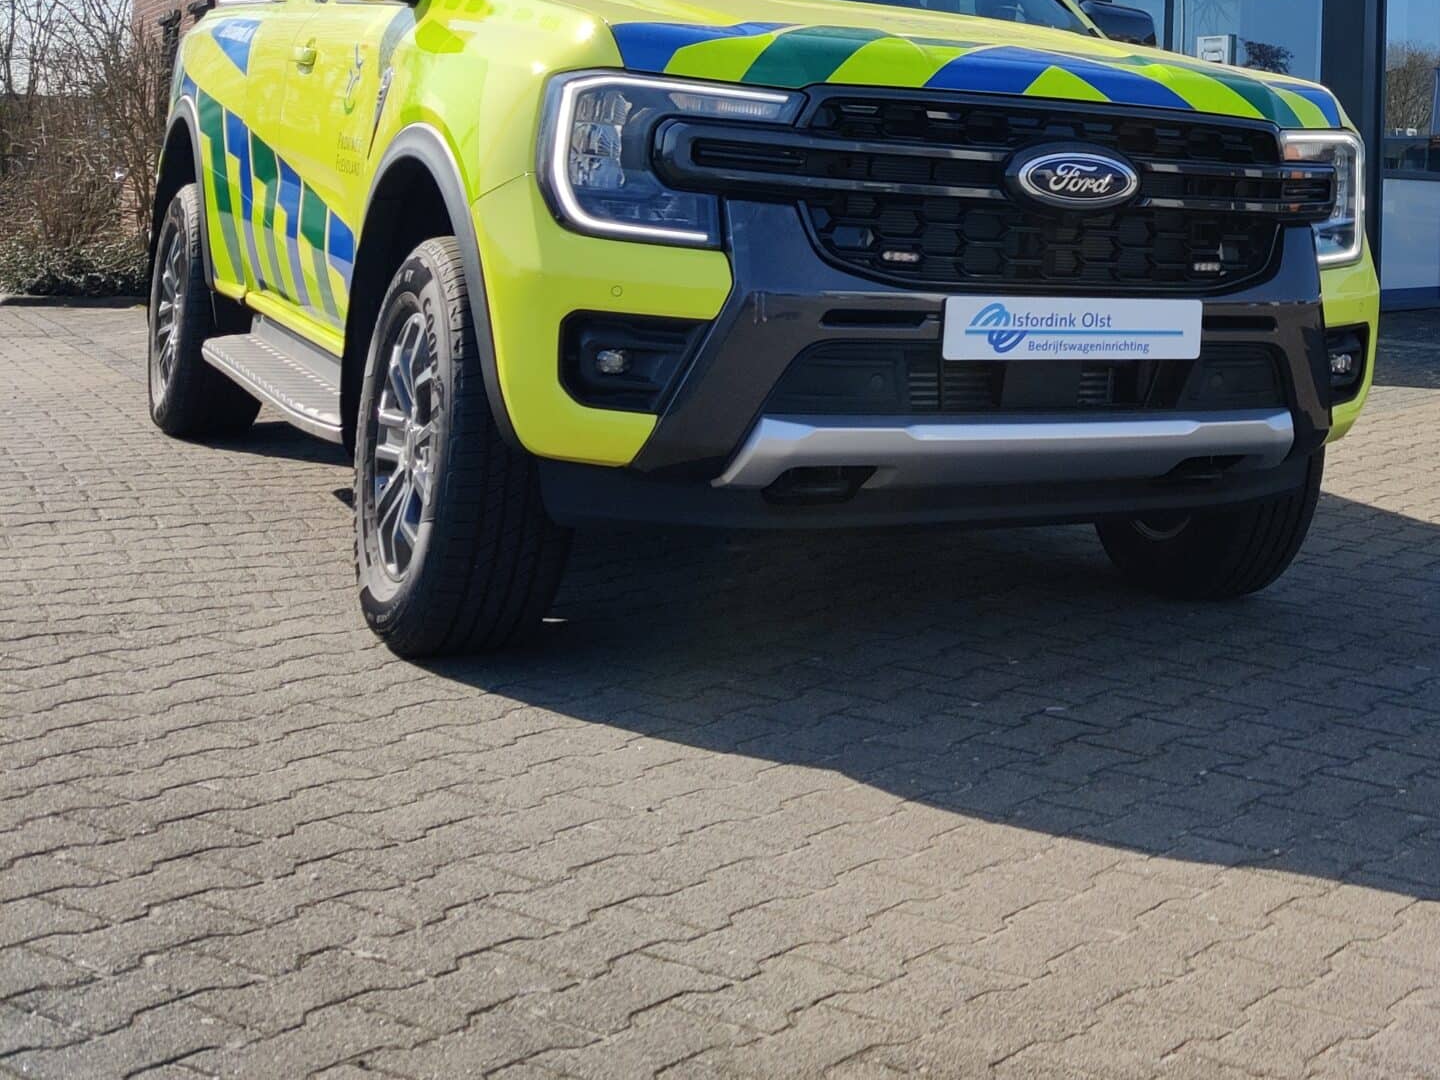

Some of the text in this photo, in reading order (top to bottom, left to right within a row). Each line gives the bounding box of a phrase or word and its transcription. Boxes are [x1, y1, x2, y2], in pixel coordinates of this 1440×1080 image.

[1048, 162, 1113, 193] Ford
[1012, 312, 1112, 328] Isfordink Olst
[1028, 340, 1150, 354] Bedrijfswageninrichting
